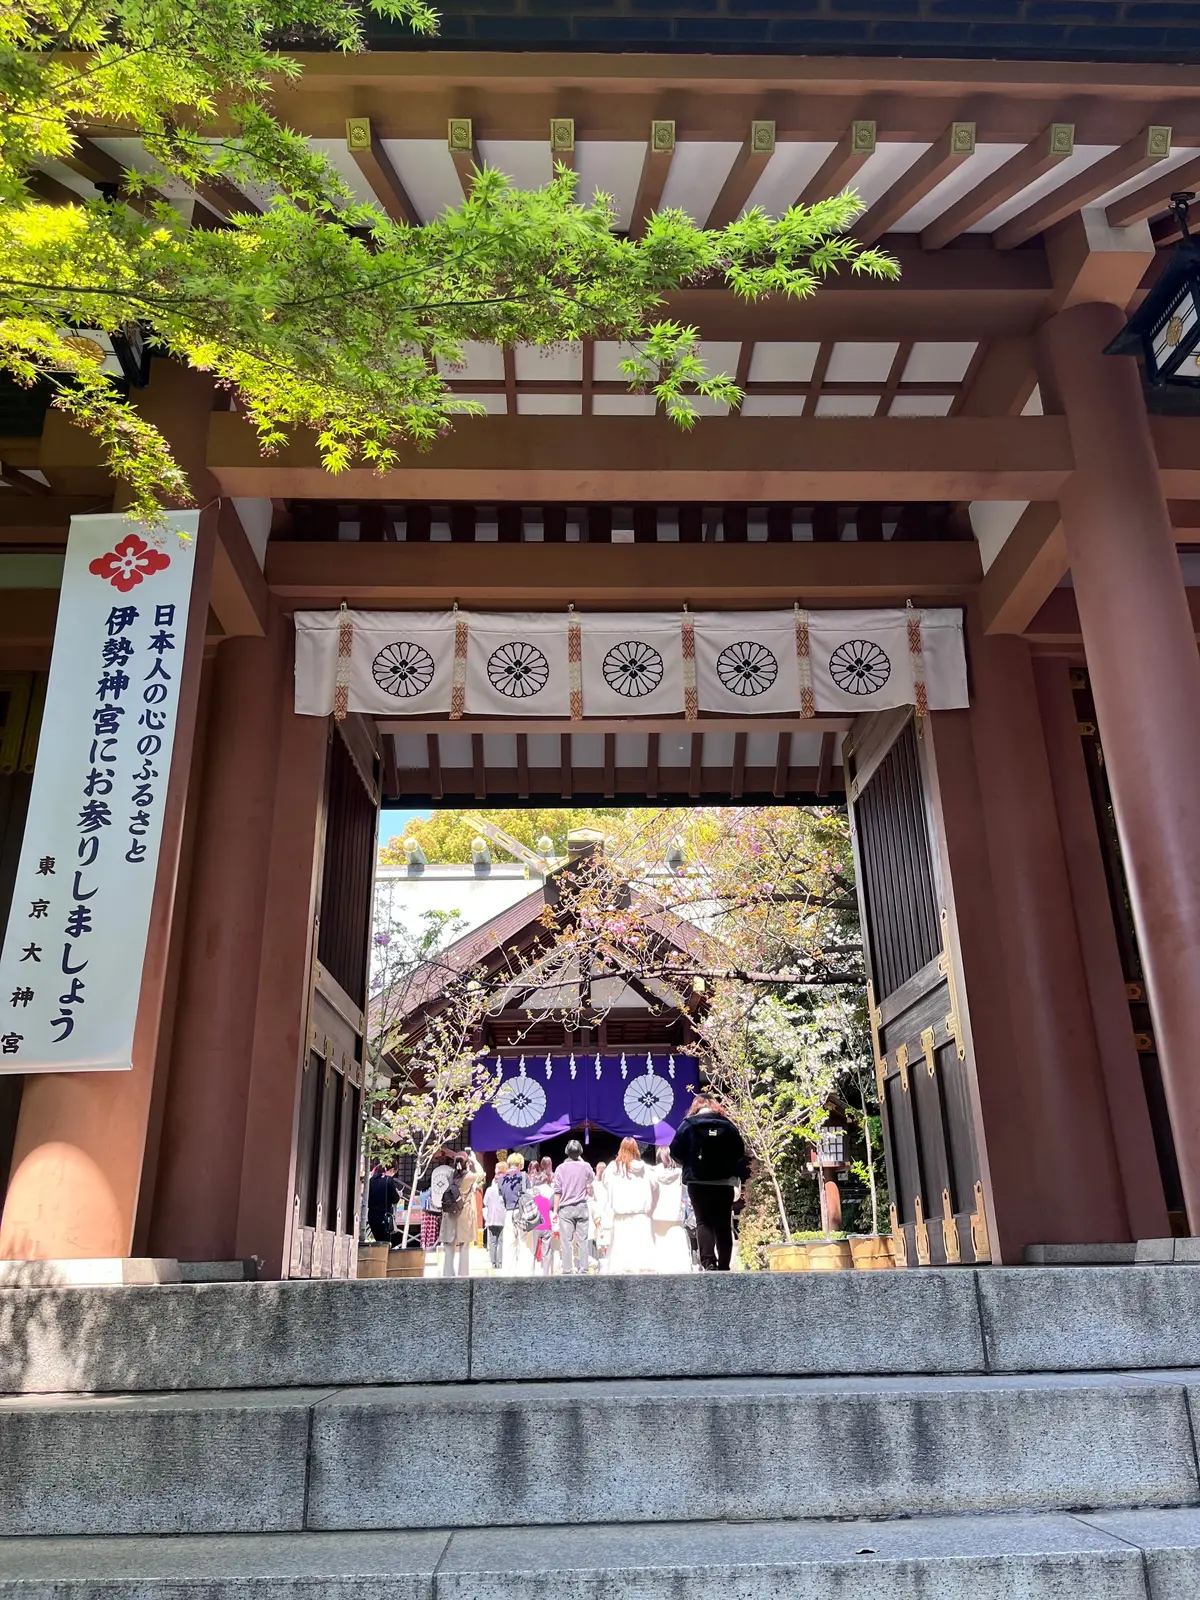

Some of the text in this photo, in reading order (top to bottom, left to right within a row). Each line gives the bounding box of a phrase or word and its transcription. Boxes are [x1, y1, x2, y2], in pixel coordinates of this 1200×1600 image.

[50, 605, 139, 1043] 伊勢神宮にお参りしましょう
[125, 604, 175, 863] 日本人の心のふるさと
[1, 856, 56, 1054] 東京大神宮
